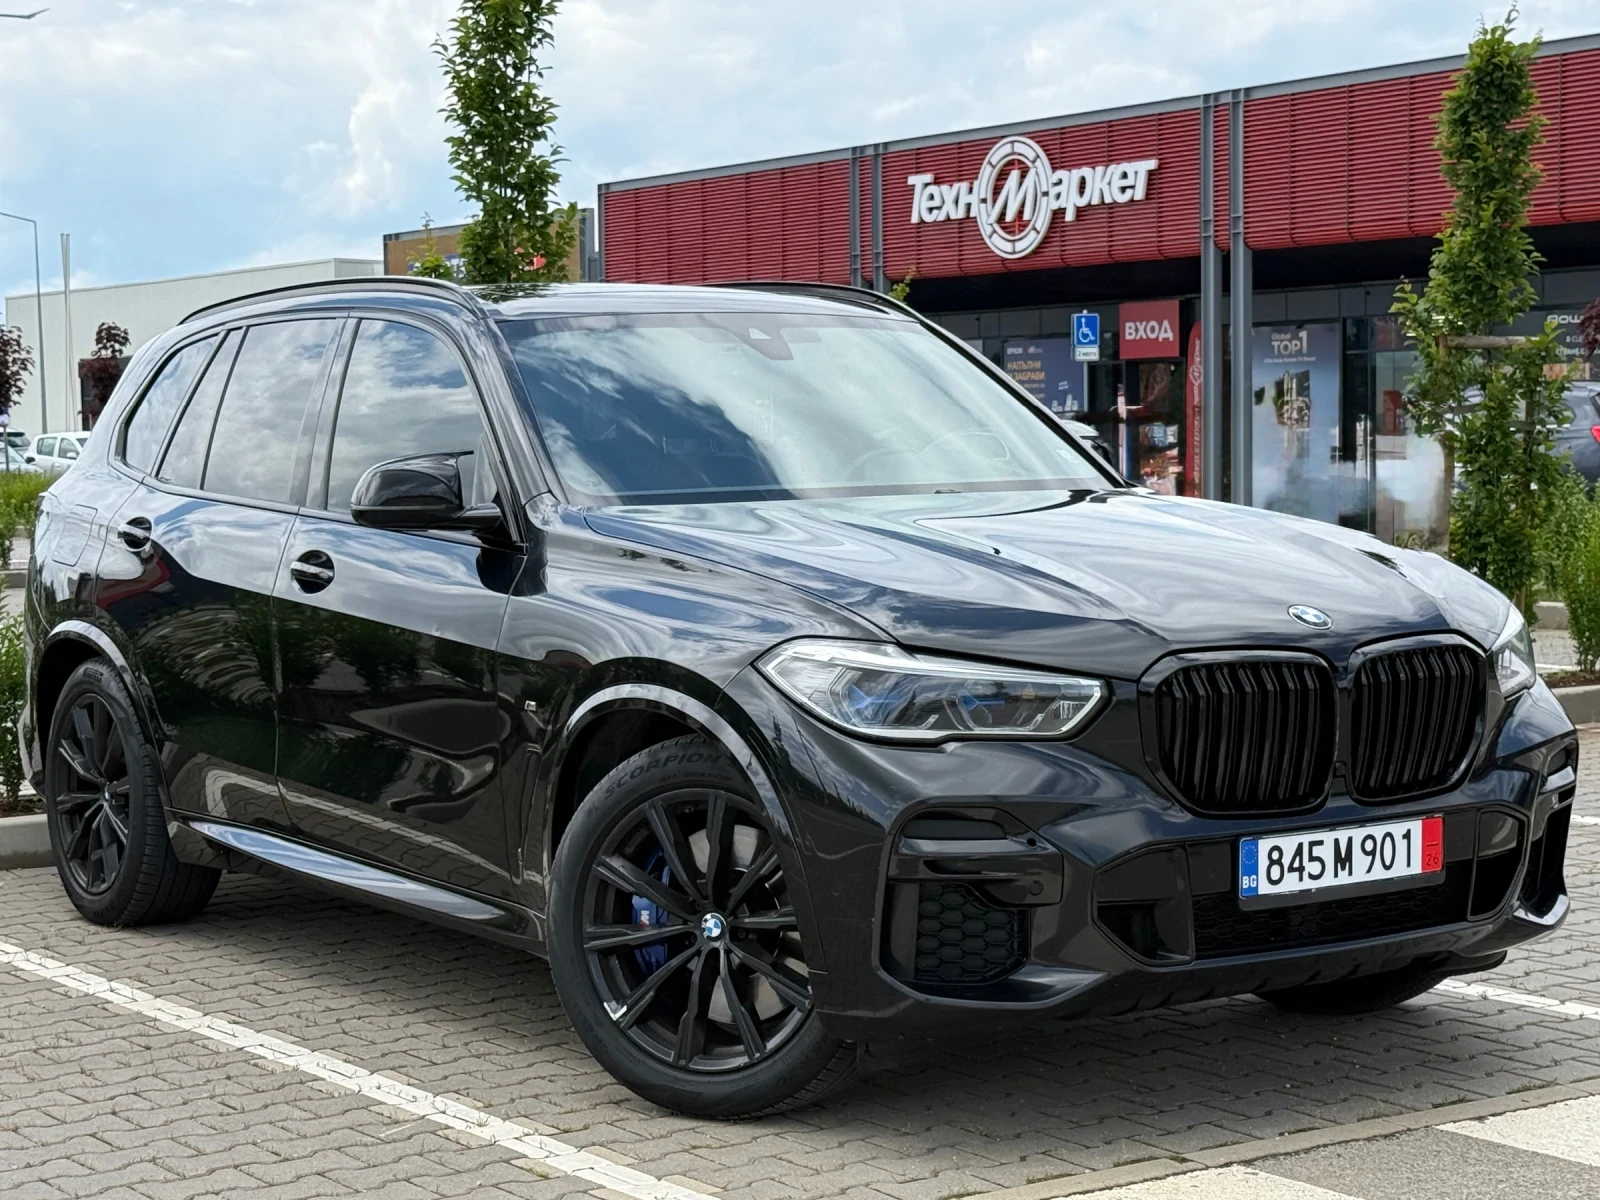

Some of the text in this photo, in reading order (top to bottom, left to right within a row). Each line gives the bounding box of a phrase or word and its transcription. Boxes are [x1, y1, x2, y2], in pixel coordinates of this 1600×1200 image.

[1124, 319, 1174, 342] ВХОД
[1271, 332, 1291, 340] Global
[1271, 340, 1301, 355] TOP
[1007, 360, 1042, 370] НАПЪЛНИ
[1015, 371, 1046, 381] ЗАБРАВИ
[604, 752, 722, 801] SCORPION
[1425, 851, 1440, 867] 26
[1242, 874, 1258, 889] BG
